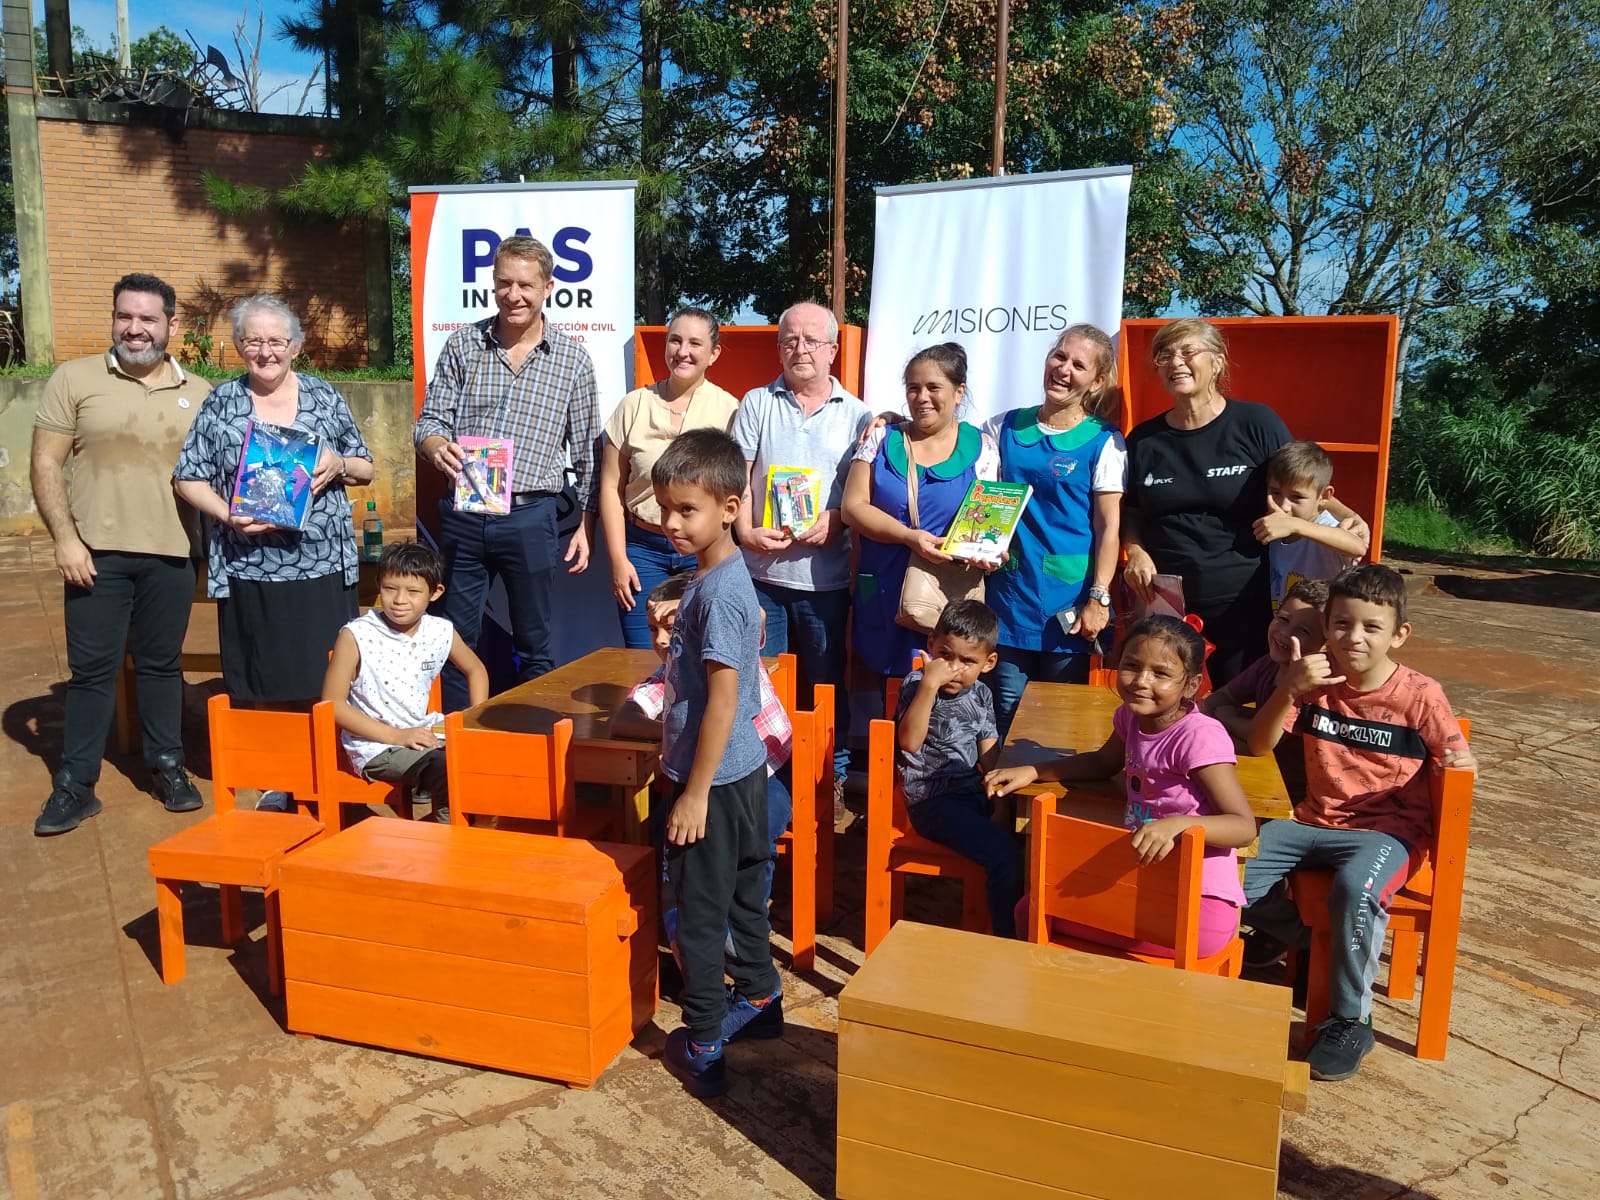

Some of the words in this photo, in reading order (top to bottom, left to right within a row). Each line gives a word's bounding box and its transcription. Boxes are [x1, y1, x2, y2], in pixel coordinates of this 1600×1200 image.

[462, 226, 593, 283] PS
[462, 288, 593, 309] INIOR
[591, 322, 616, 332] CIVIL
[912, 304, 1068, 335] MISIONES
[307, 432, 316, 445] 2
[1206, 465, 1247, 478] STAFF
[1312, 714, 1392, 747] BROOKLYN
[1369, 844, 1392, 878] TOMMY
[1350, 891, 1371, 952] HILFIGER
